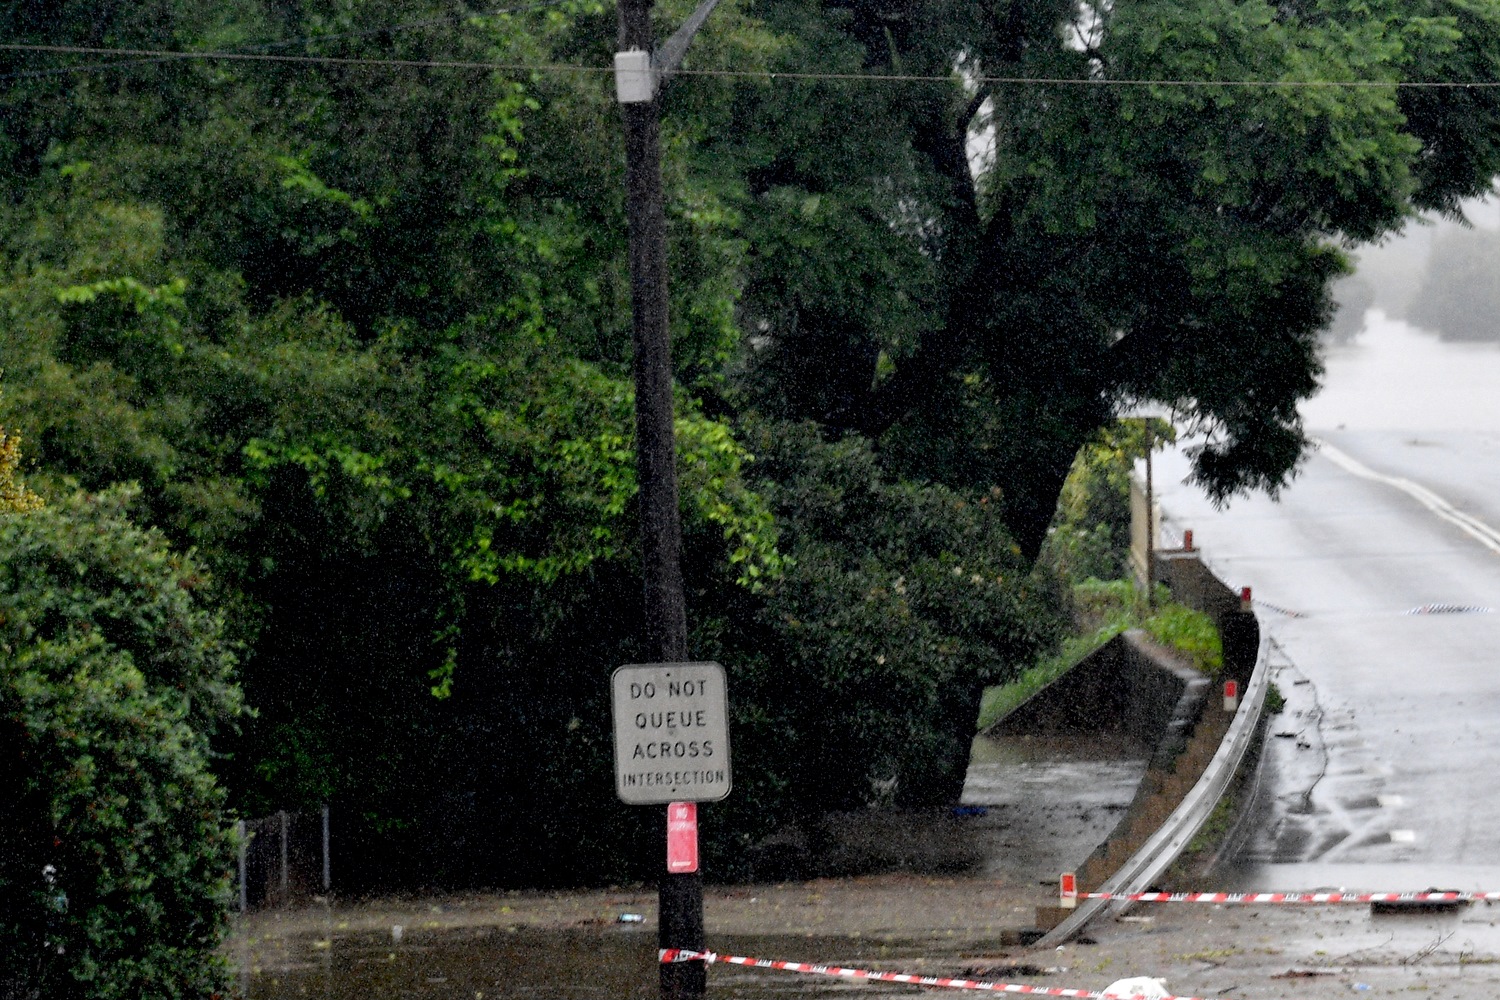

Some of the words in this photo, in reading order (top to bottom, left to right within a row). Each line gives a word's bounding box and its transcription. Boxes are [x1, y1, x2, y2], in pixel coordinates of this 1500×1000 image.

[630, 682, 656, 700] DO
[669, 680, 706, 698] NOT
[635, 710, 707, 730] QUEUE
[632, 740, 714, 760] ACROSS
[623, 769, 724, 787] INTERSECTION
